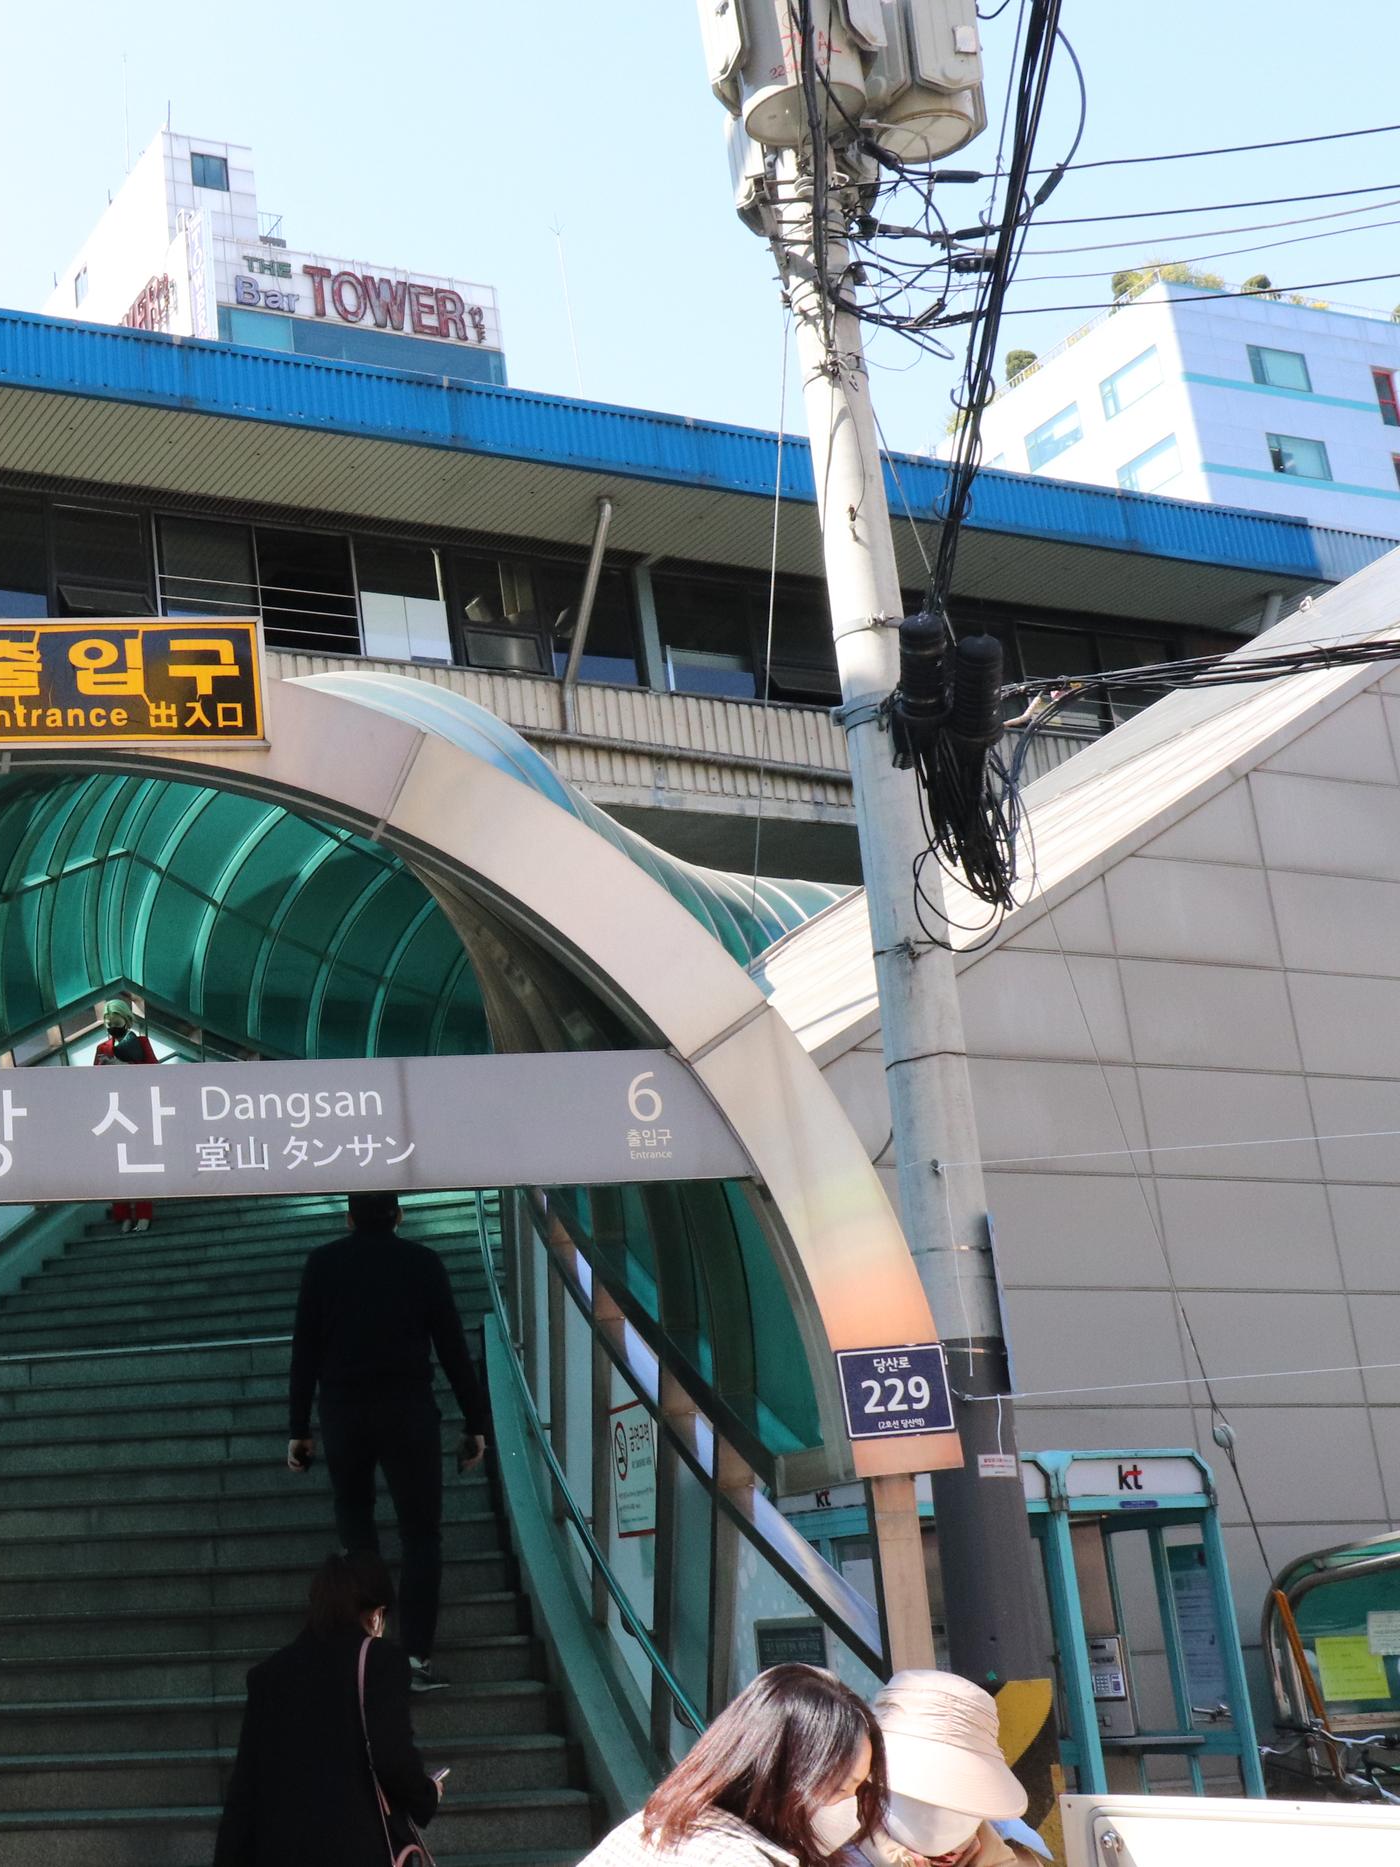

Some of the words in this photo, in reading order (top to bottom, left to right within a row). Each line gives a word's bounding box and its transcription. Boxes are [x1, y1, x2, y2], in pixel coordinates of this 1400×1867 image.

[243, 255, 292, 279] THE
[235, 275, 299, 313] Bar
[303, 265, 468, 341] TOWER
[148, 701, 244, 728] 出入口
[201, 1086, 383, 1128] Dangsan
[628, 1071, 662, 1121] 6
[625, 1129, 673, 1147] 출입구
[195, 1136, 270, 1172] 堂山
[282, 1134, 416, 1170] タンサン
[630, 1150, 673, 1160] Entrance
[873, 1356, 911, 1373] 당산로
[861, 1375, 931, 1414] 229
[878, 1420, 900, 1430] (2호선
[1118, 1465, 1143, 1490] kt
